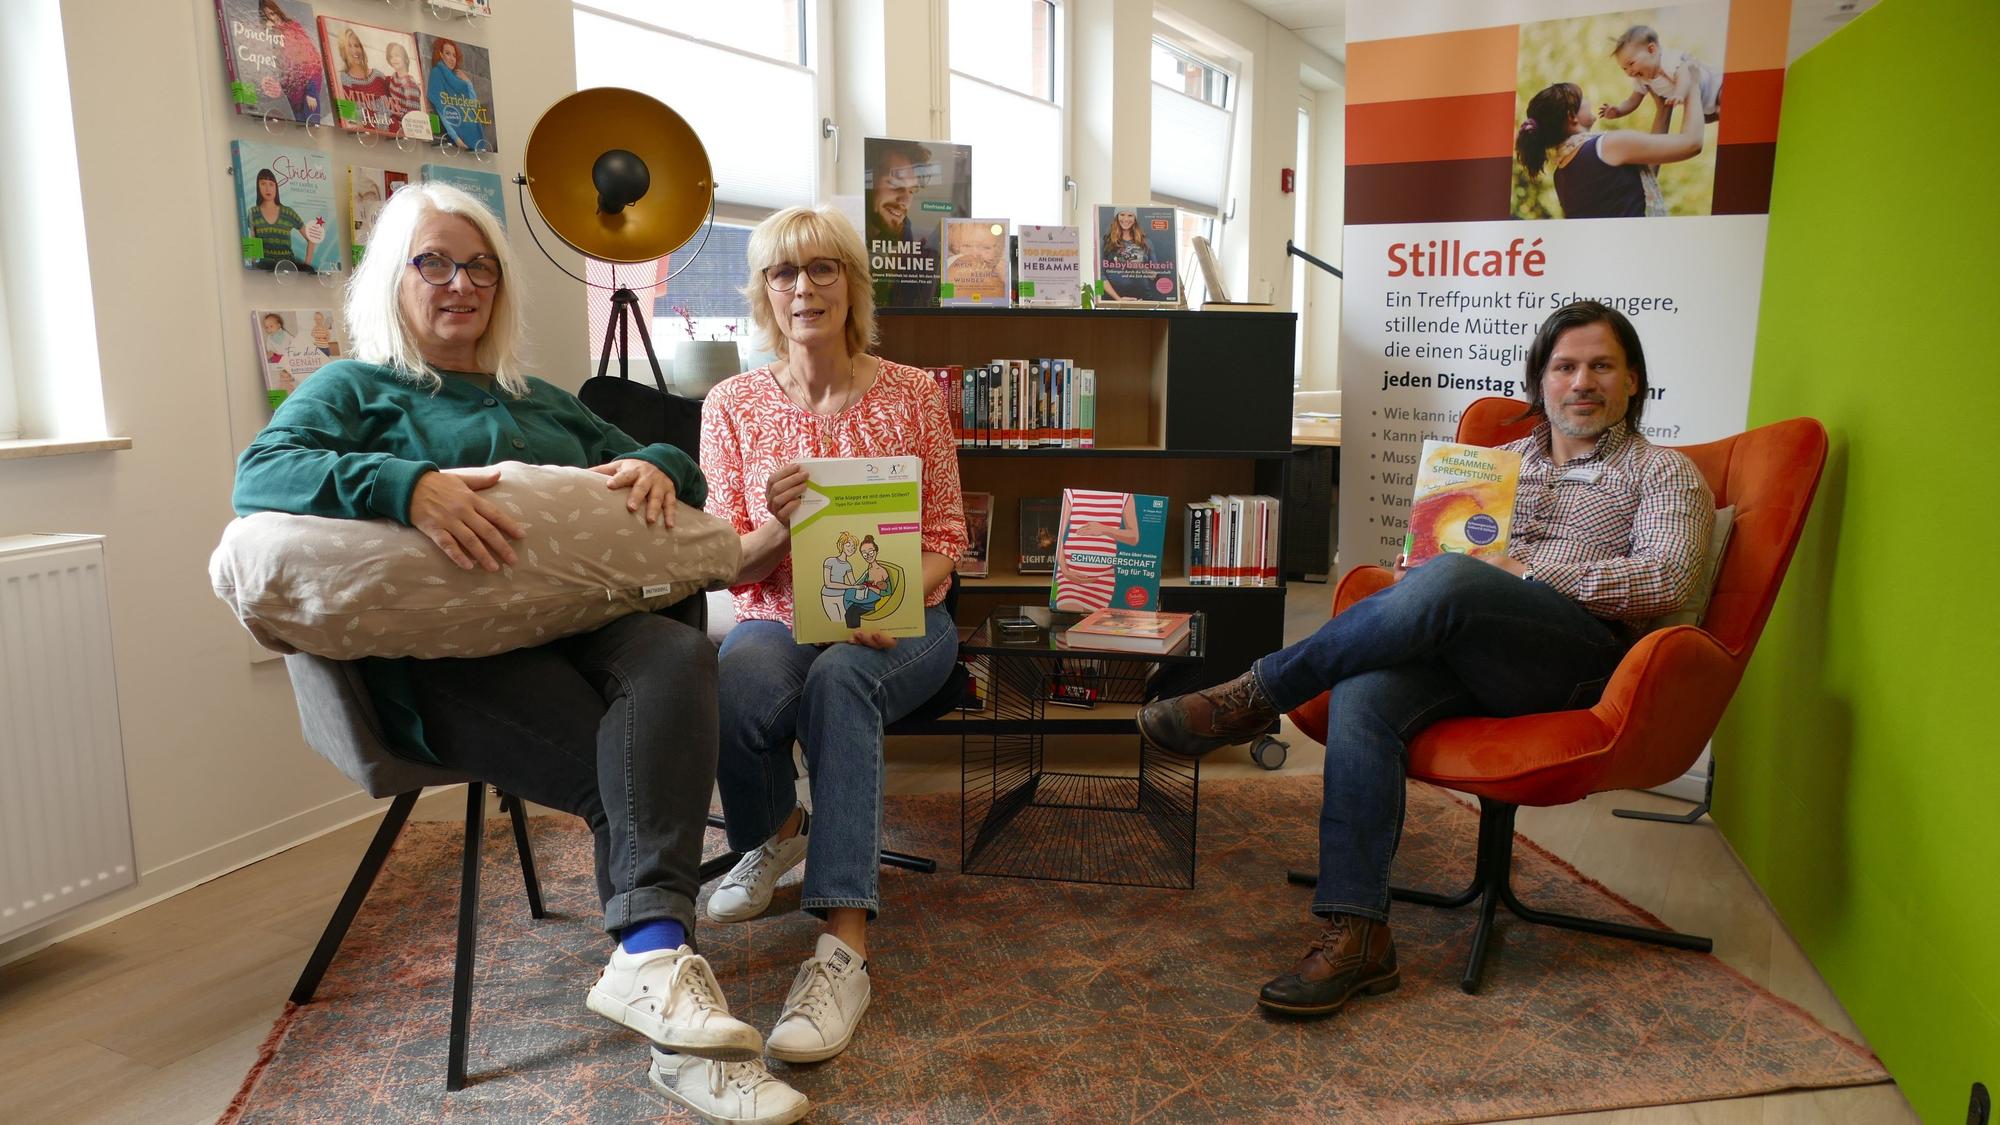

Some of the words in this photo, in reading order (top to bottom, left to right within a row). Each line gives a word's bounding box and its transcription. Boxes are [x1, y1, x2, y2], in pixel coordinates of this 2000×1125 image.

[233, 21, 285, 47] Ponchos
[238, 45, 277, 71] Capes
[440, 91, 480, 108] Stricken
[462, 106, 491, 124] XXL
[272, 155, 327, 187] Stricken
[872, 239, 922, 254] FILME
[871, 256, 934, 271] ONLINE
[1102, 259, 1174, 270] Babybauchzeit
[1387, 237, 1546, 277] Stillcafé
[1023, 262, 1079, 271] HEBAMME
[1386, 292, 1411, 307] Ein
[1417, 291, 1511, 312] Treffpunkt
[1517, 292, 1545, 309] für
[1385, 317, 1460, 333] stillende
[1465, 318, 1528, 335] Mütter
[1384, 341, 1410, 358] die
[1415, 342, 1463, 359] einen
[1468, 344, 1529, 366] Säugli
[1382, 371, 1431, 391] jeden
[1437, 373, 1515, 397] Dienstag
[1384, 407, 1409, 420] Wie
[1413, 409, 1445, 423] kann
[1383, 429, 1416, 442] Kann
[1382, 451, 1417, 464] Muss
[1463, 449, 1479, 458] DIE
[1441, 457, 1497, 471] HEBAMMEN-
[1382, 472, 1414, 486] Wird
[1432, 465, 1504, 483] SPRECHSTUNDE
[1381, 514, 1409, 528] Was
[1022, 555, 1045, 564] LICHT
[1071, 554, 1156, 569] SCHWANGERSCHAFT
[1117, 567, 1129, 577] Tag
[1130, 568, 1141, 576] für
[1143, 569, 1155, 579] Tag
